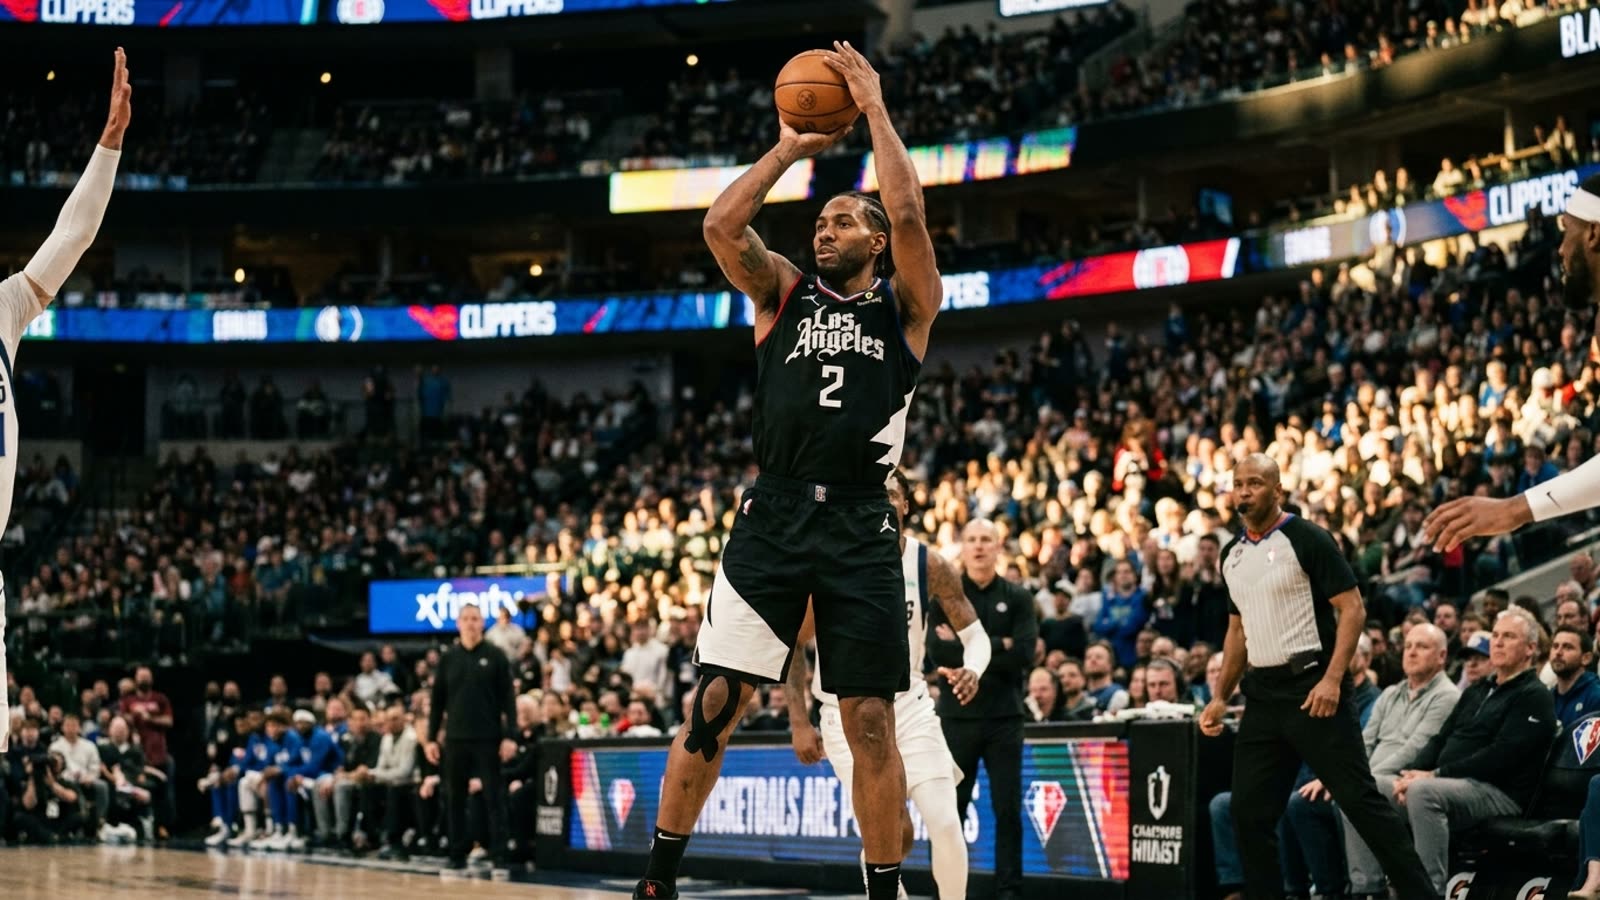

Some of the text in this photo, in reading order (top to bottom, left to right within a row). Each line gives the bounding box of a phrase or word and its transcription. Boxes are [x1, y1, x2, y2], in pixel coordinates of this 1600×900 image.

[41, 0, 135, 25] CLIPPERS
[1489, 169, 1579, 226] CLIPPERS
[459, 301, 557, 339] CLIPPERS
[785, 317, 884, 364] Angeles
[819, 365, 844, 408] 2
